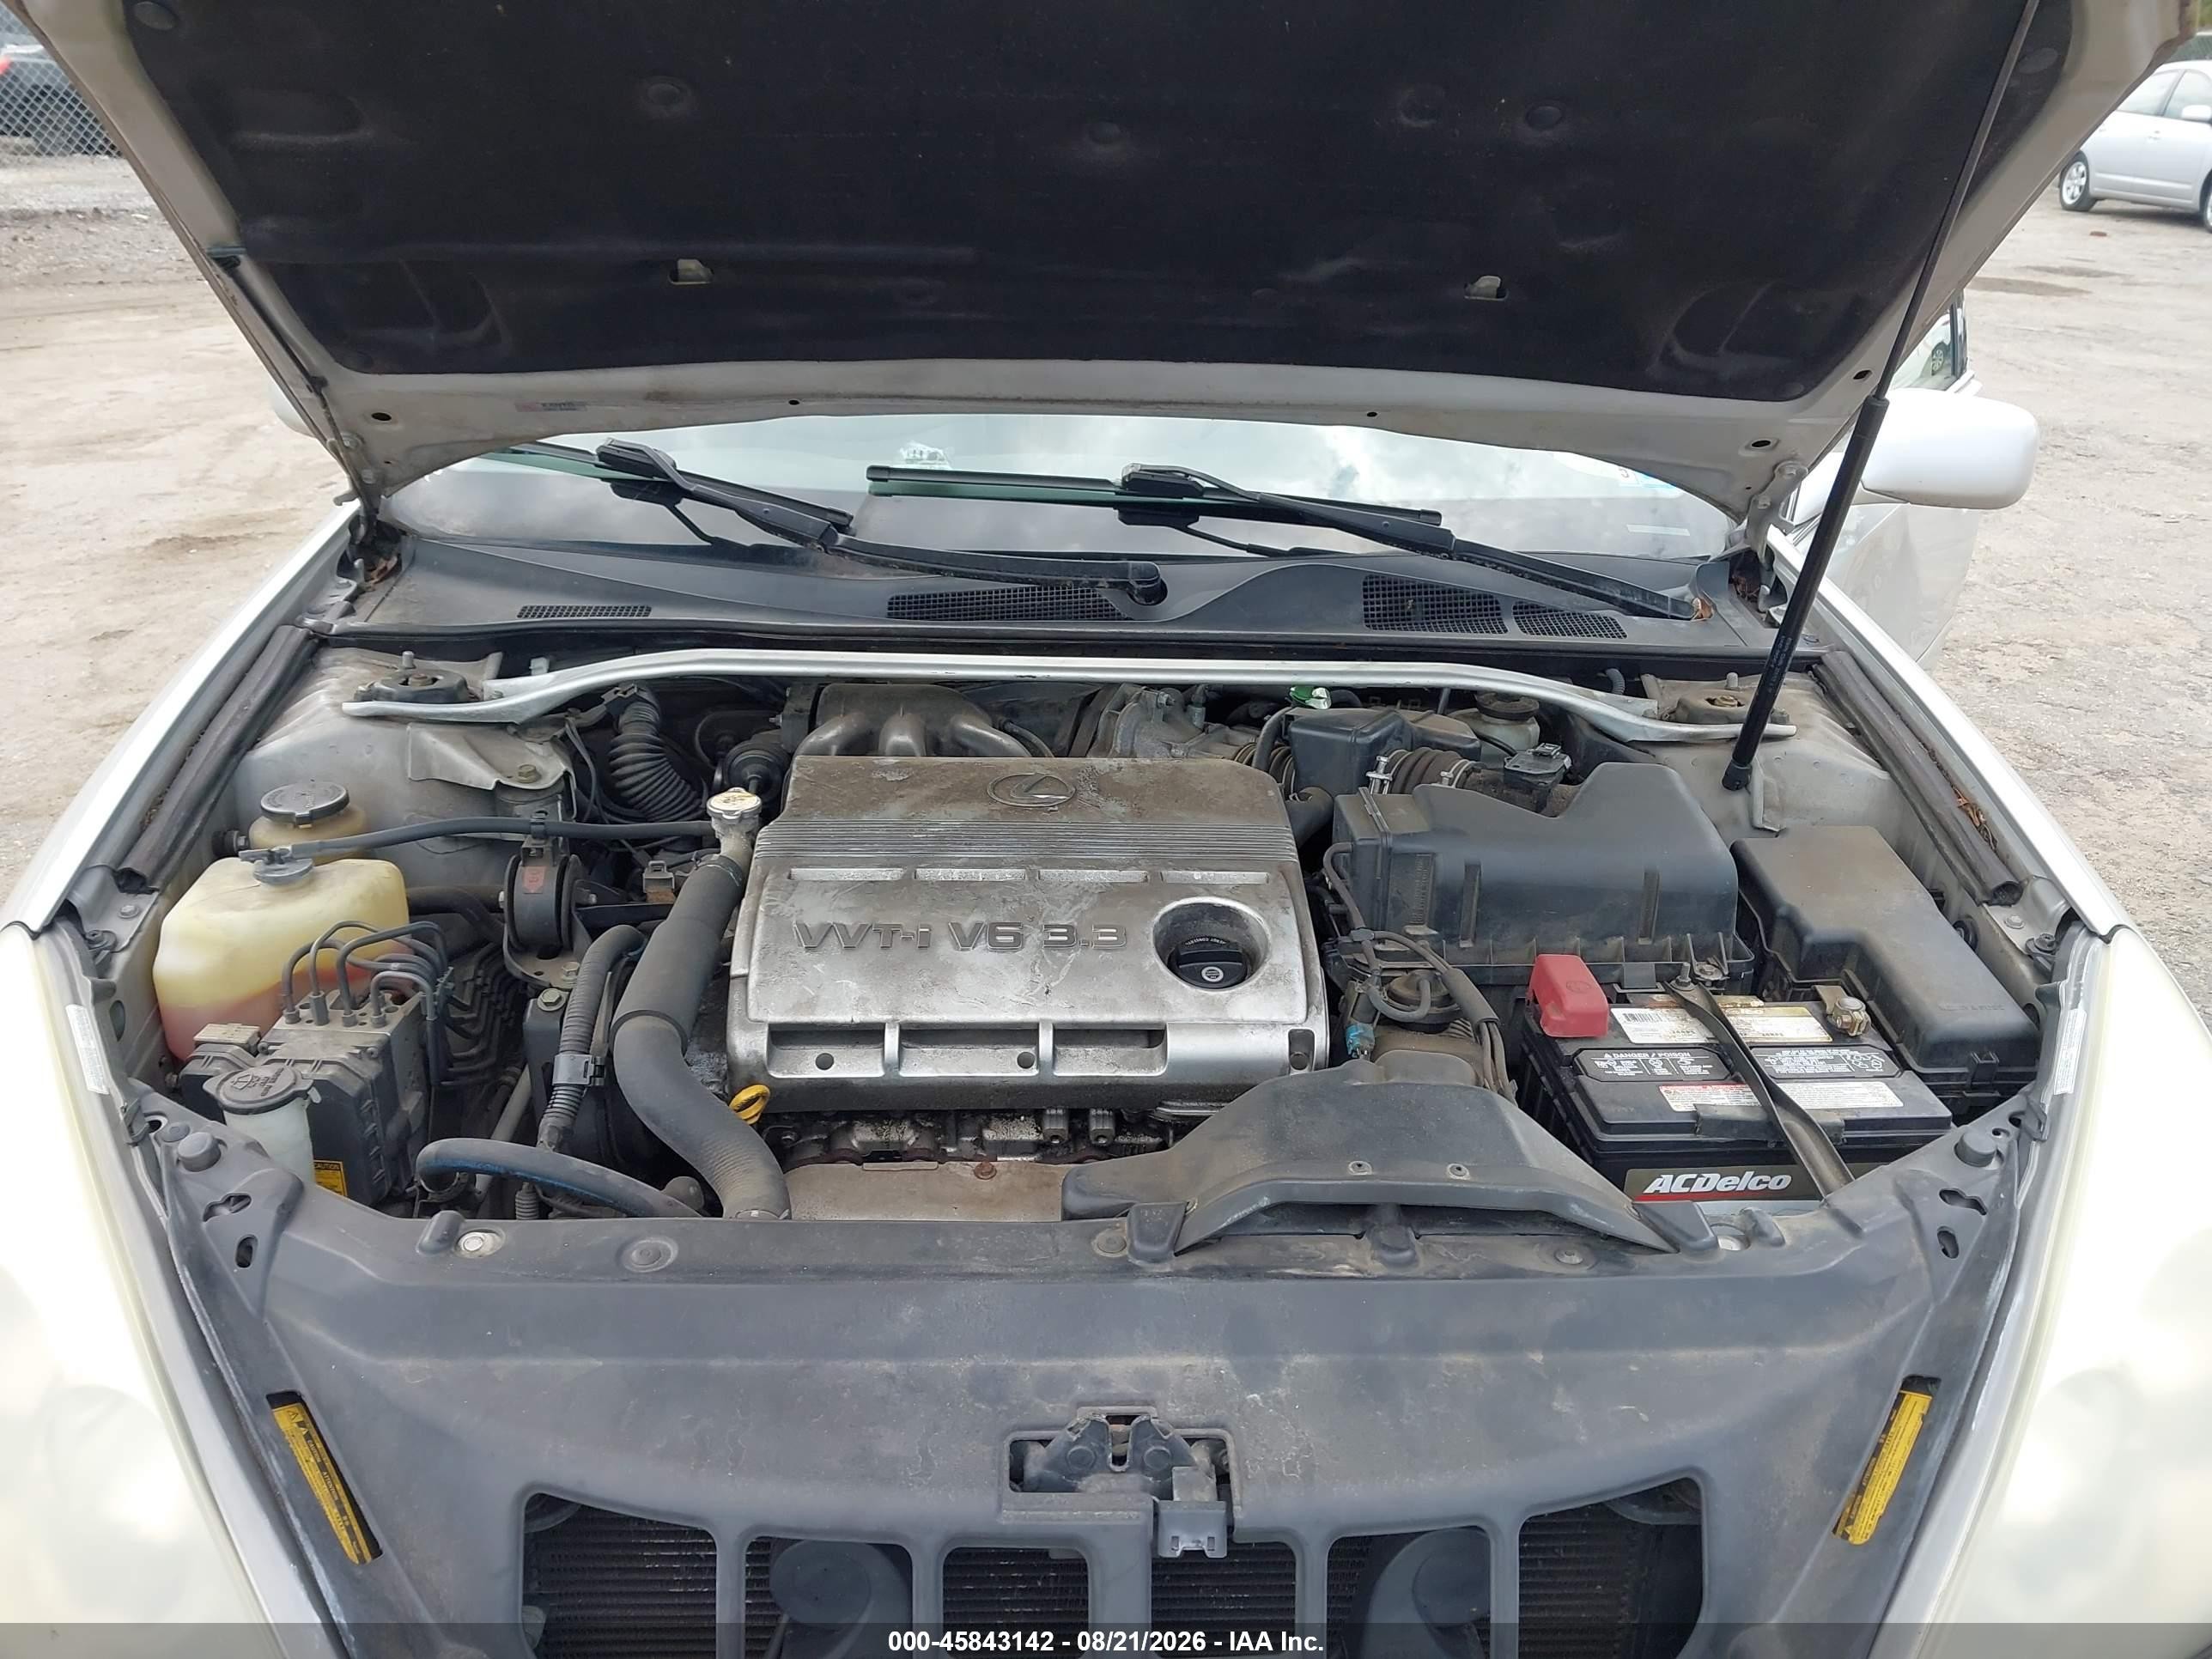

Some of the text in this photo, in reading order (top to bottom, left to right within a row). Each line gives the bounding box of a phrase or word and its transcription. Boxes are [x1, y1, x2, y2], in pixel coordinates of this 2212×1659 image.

[793, 921, 1127, 951] VVT-i V6 3.3
[1643, 1170, 1792, 1194] ACDelco
